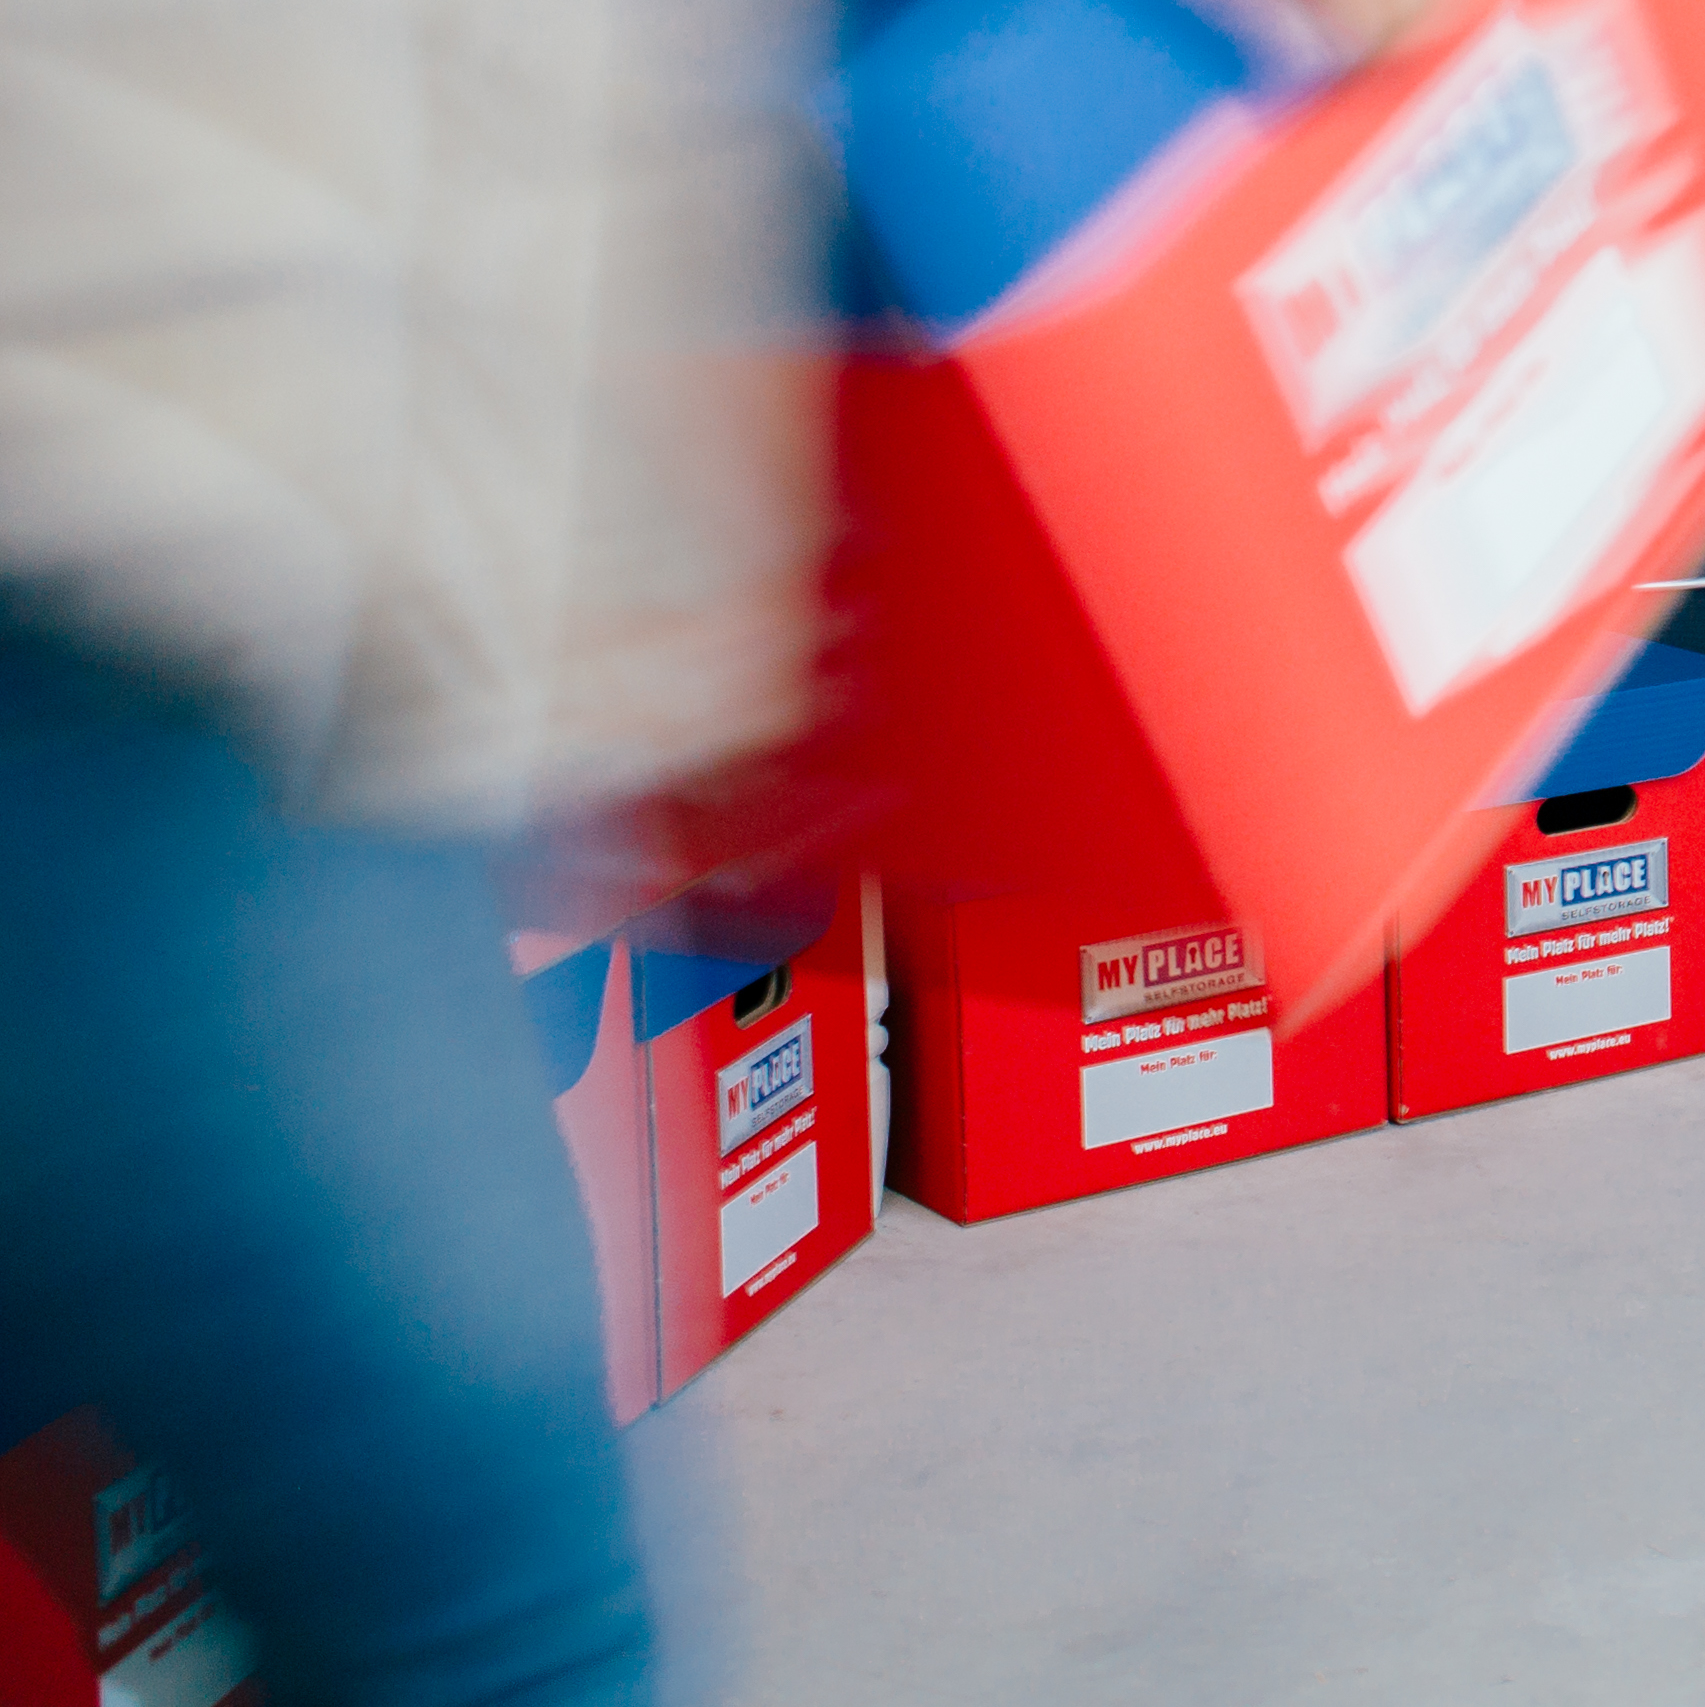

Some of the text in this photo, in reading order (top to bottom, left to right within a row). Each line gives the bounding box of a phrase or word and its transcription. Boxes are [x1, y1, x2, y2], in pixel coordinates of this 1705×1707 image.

[1522, 858, 1646, 909] MY PLACE
[1561, 895, 1651, 921] SELFSTORAGE
[1098, 932, 1240, 991] MY PLACE
[1505, 944, 1539, 965] Mein
[1542, 937, 1574, 958] Platz
[1578, 933, 1596, 951] für
[1599, 926, 1631, 946] mehr
[1082, 1032, 1121, 1054] Mein
[1125, 1023, 1162, 1044] Platz
[1163, 1017, 1185, 1036] für
[1189, 1008, 1225, 1030] mehr
[1140, 1061, 1166, 1076] Mein
[1170, 1055, 1195, 1069] Platz
[1132, 1123, 1228, 1155] www.myplace.eu
